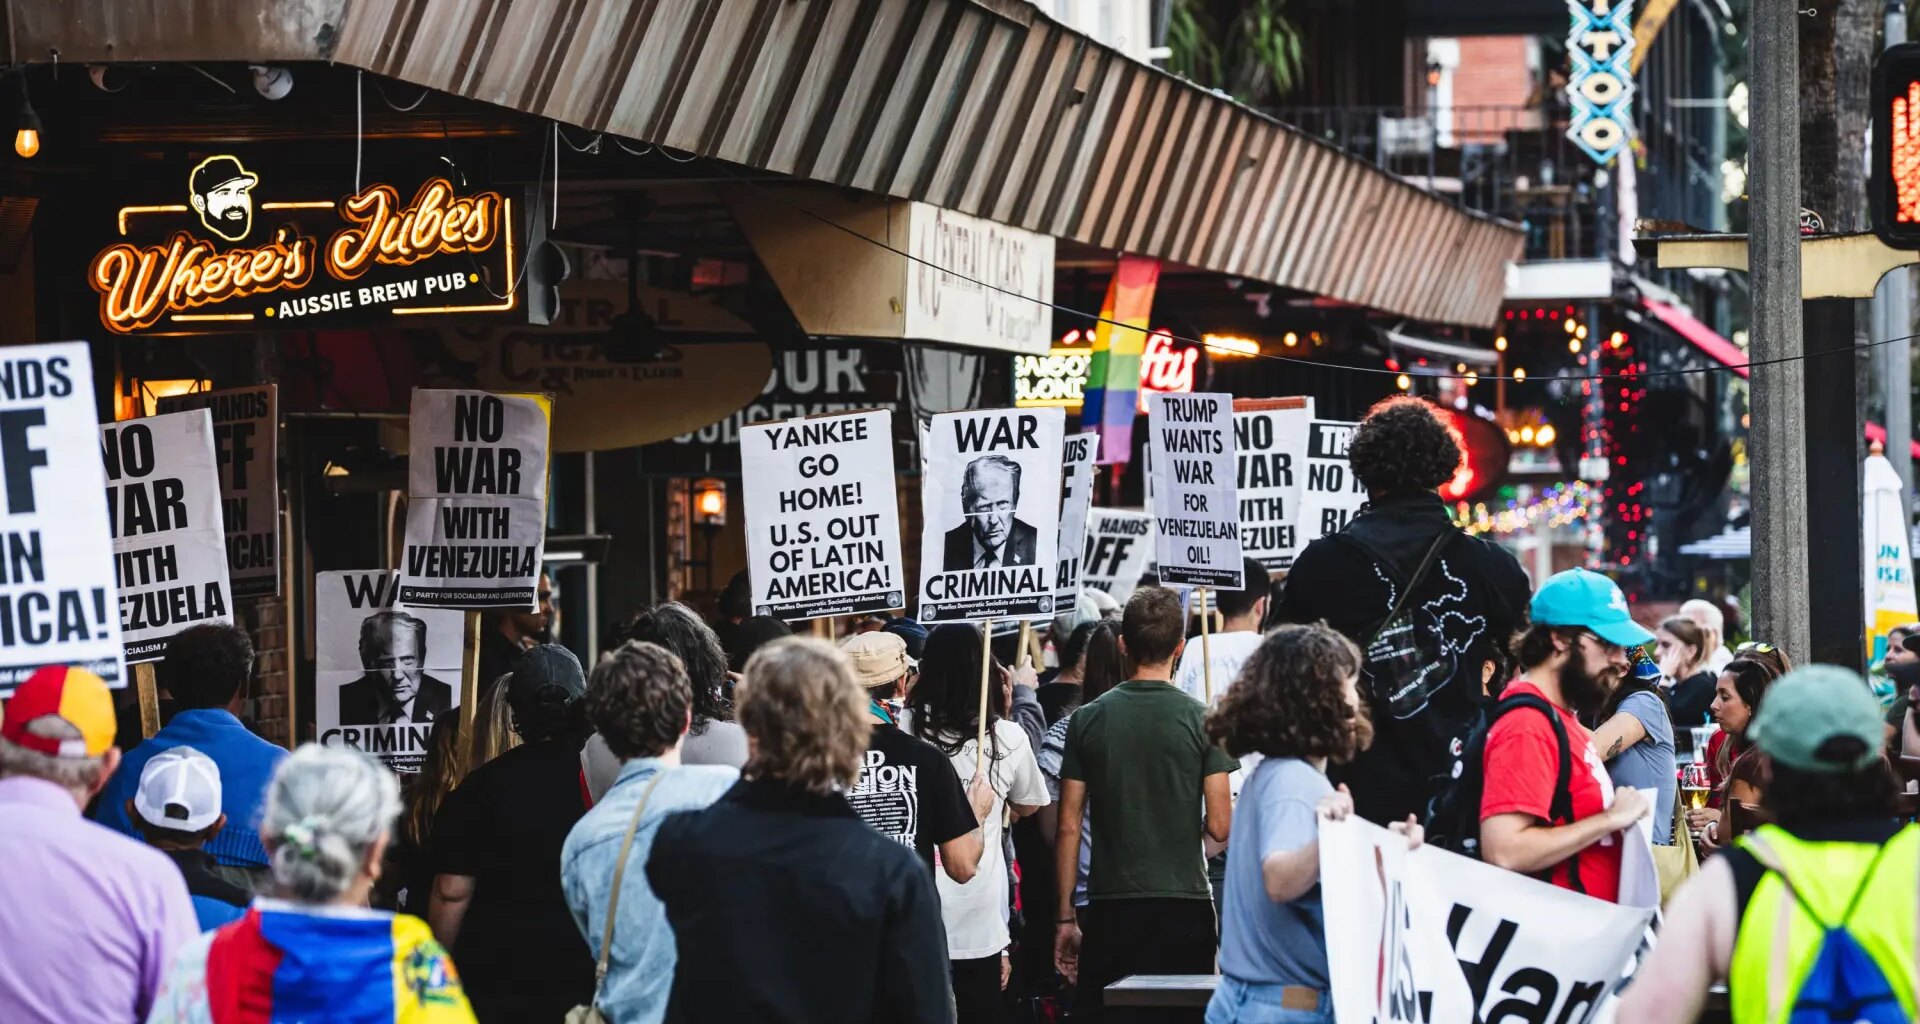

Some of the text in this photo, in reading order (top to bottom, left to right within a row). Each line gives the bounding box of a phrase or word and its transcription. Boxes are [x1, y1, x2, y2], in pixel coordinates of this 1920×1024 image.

[90, 178, 499, 333] Where's Jubes
[278, 271, 467, 319] AUSSIE BREW PUB
[0, 356, 72, 400] NDS
[453, 394, 505, 443] NO
[1162, 397, 1218, 423] TRUMP
[764, 417, 868, 450] YANKEE
[953, 414, 1040, 453] WAR
[1162, 429, 1223, 455] WANTS
[1234, 415, 1274, 451] NO
[434, 447, 522, 496] WAR
[798, 453, 840, 479] GO
[1174, 460, 1215, 485] WAR
[1308, 464, 1344, 493] NO
[780, 482, 863, 513] HOME!
[1184, 493, 1208, 512] FOR
[443, 507, 510, 540] WITH
[769, 513, 881, 547] U.S. OUT
[1098, 518, 1150, 536] HANDS
[1157, 517, 1238, 541] VENEZUELAN
[115, 544, 179, 589] ITH
[408, 545, 536, 579] VENEZUELA
[769, 540, 885, 573] OF LATIN
[1187, 546, 1211, 565] OIL!
[415, 591, 440, 600] PARTY
[453, 592, 488, 600] SOCIALISM
[501, 591, 533, 599] LIBERATION
[765, 565, 892, 601] AMERICA!
[925, 567, 1049, 602] CRIMINAL
[0, 587, 109, 648] ICA!
[119, 581, 227, 632] EZUELA
[773, 594, 885, 612] Pinellas Democratic Socialists of America
[806, 605, 854, 617] pinellasdsa.org
[937, 597, 1037, 611] Pinellas Democratic Socialists of America
[965, 608, 1008, 619] pinellasdsa.org
[321, 726, 430, 752] CRIMIN
